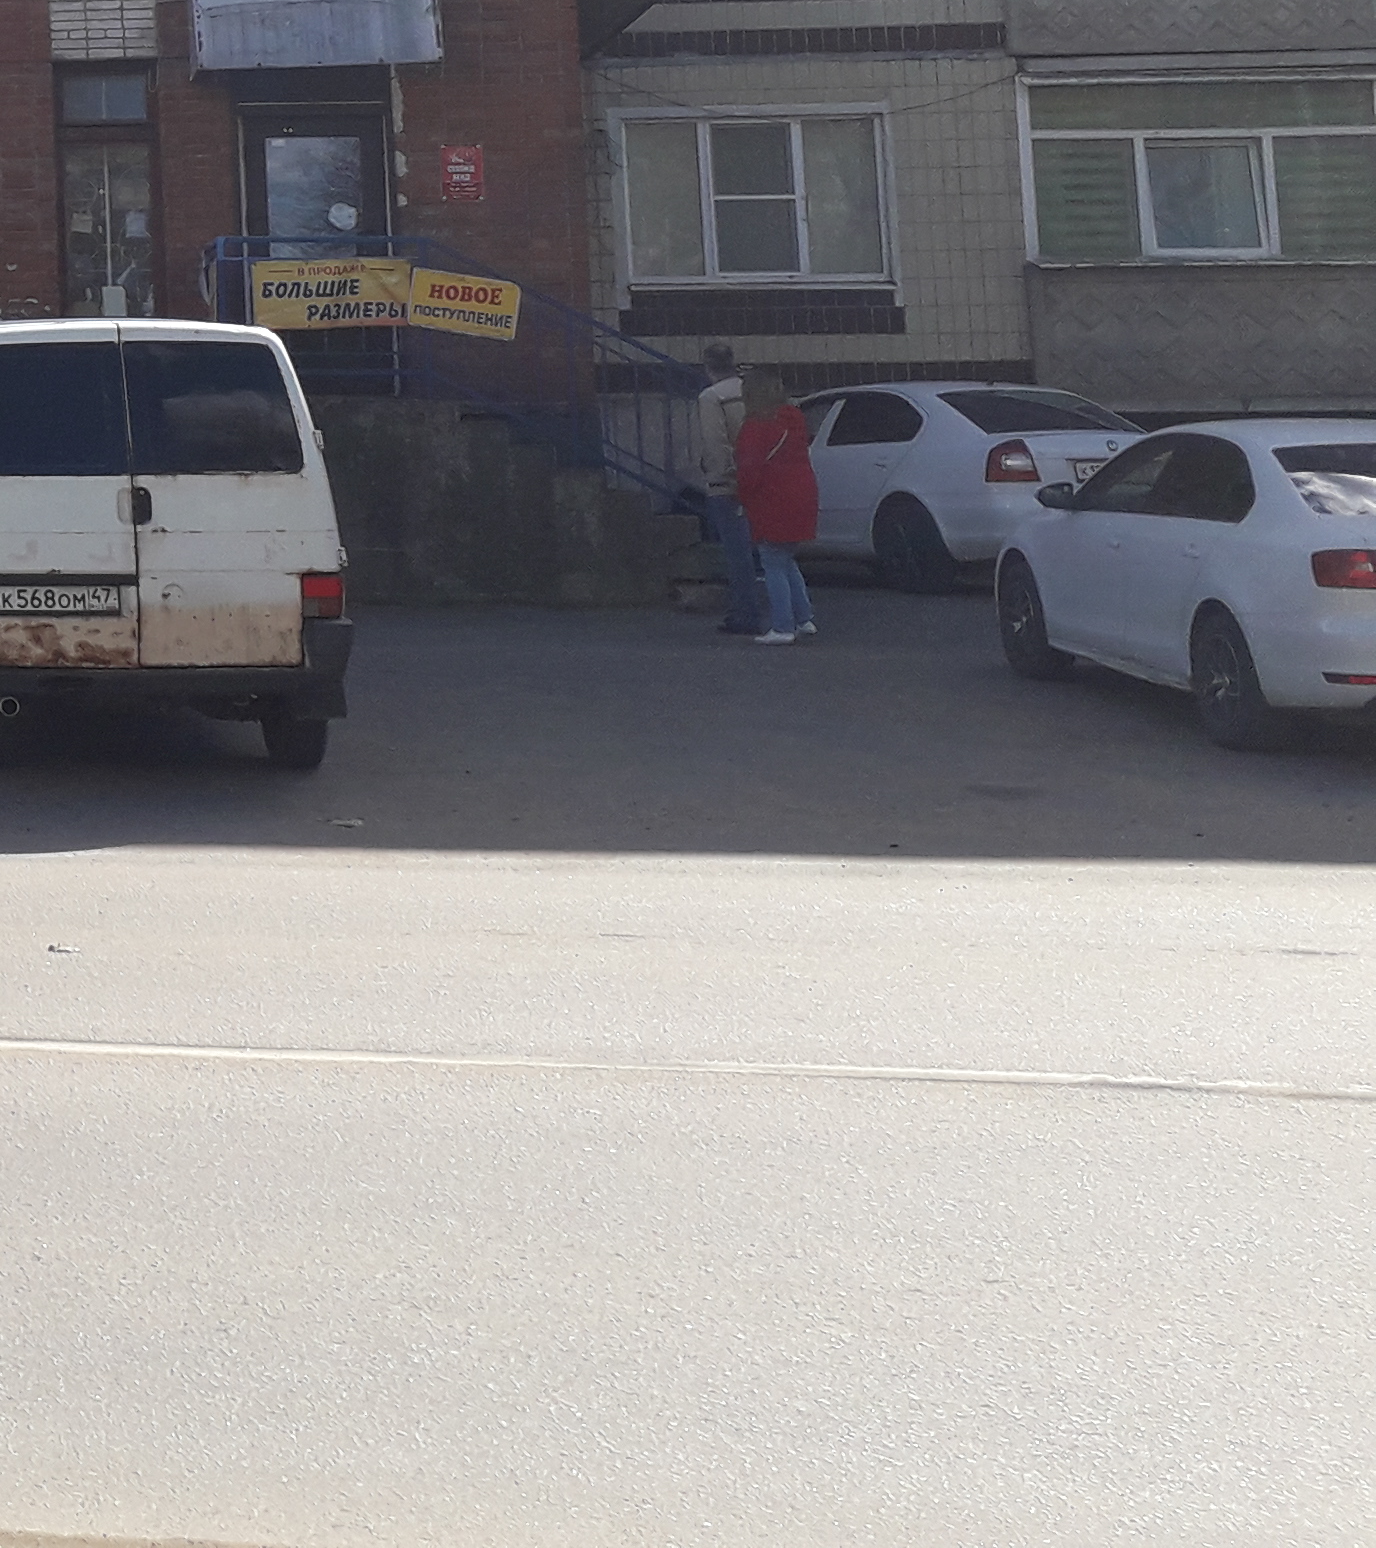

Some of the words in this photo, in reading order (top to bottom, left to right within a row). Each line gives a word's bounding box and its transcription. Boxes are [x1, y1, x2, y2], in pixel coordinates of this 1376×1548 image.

[261, 278, 360, 299] БОЛЬШИЕ
[428, 283, 504, 306] НОВОЕ
[306, 301, 408, 322] РАЗМЕРЫ
[413, 304, 513, 330] ПОСТУПЛЕНИЕ
[0, 588, 87, 610] К568ОМ
[91, 587, 112, 605] 47
